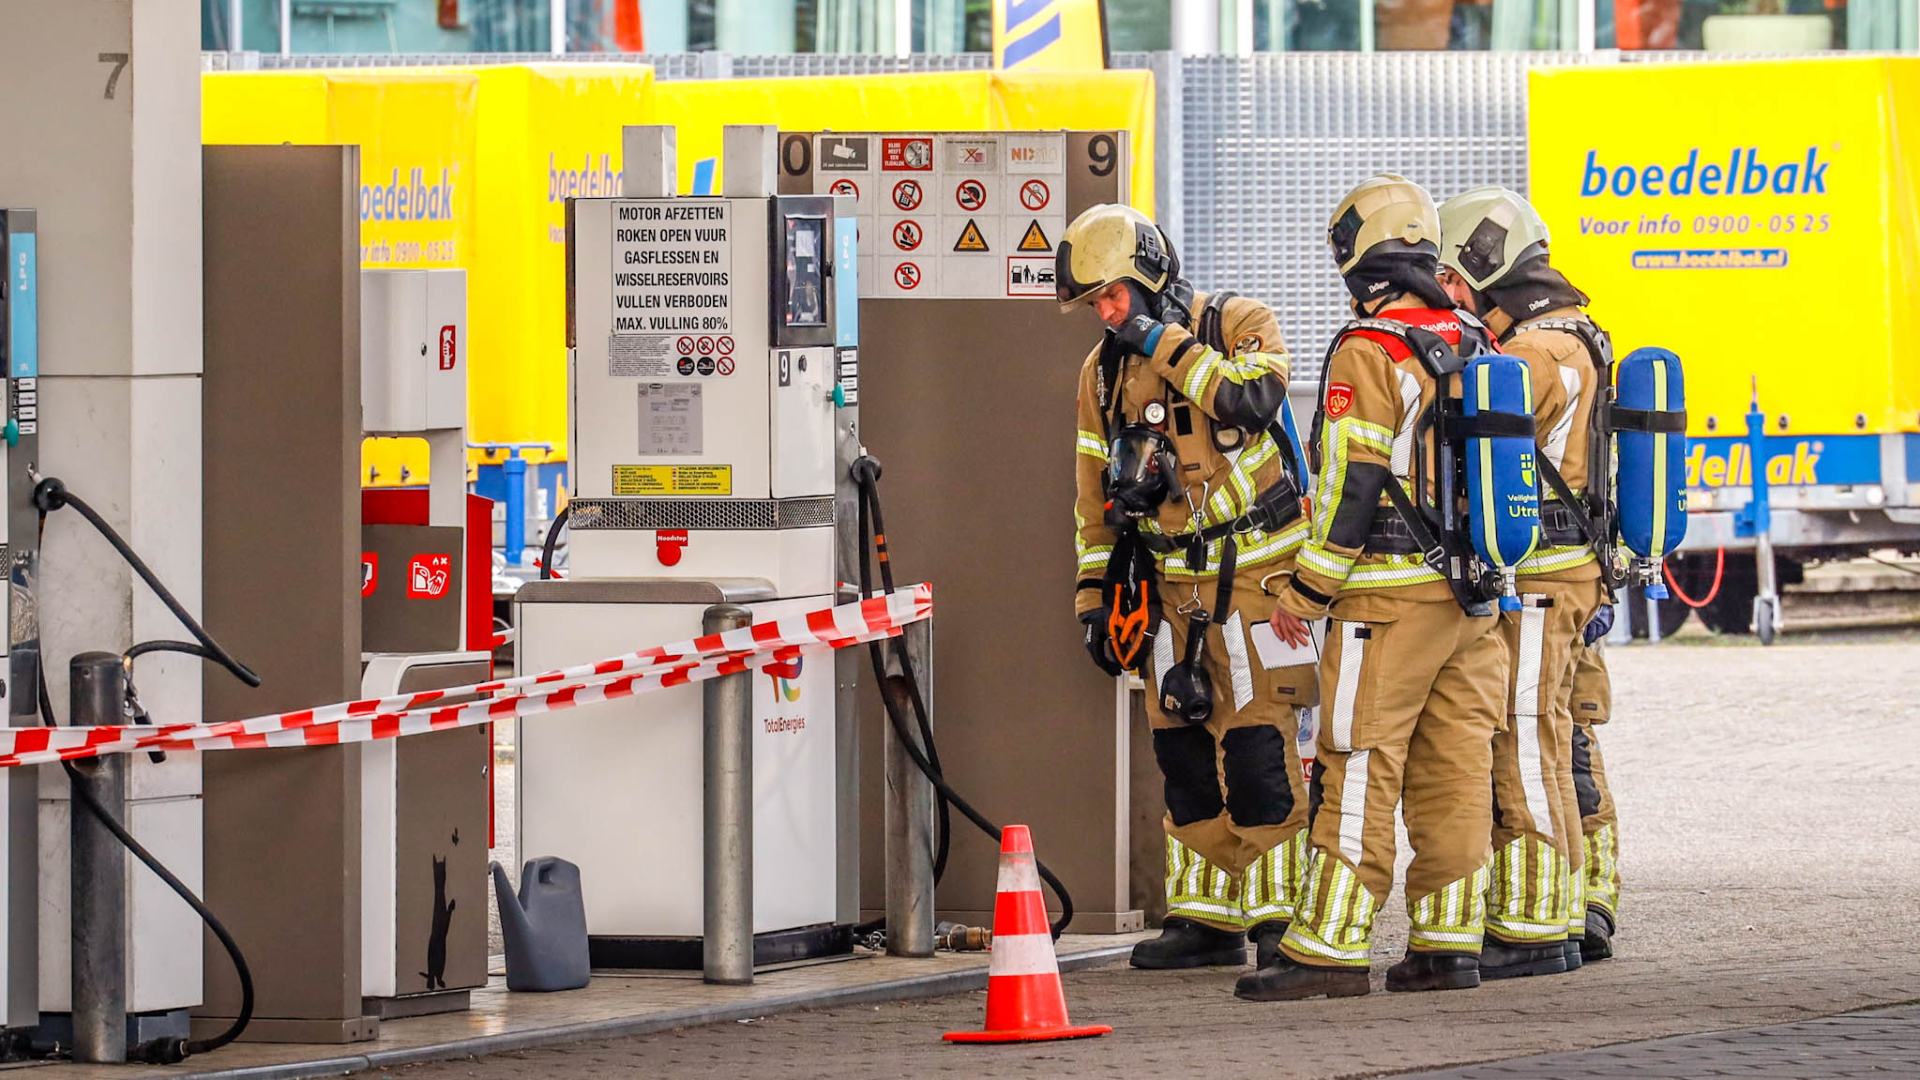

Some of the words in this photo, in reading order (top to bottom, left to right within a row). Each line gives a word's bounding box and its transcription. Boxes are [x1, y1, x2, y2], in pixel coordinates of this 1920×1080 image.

[98, 53, 128, 100] 7
[1088, 134, 1116, 177] 9
[1580, 146, 1830, 197] boedelbak
[620, 207, 660, 220] MOTOR
[664, 206, 723, 220] AFZETTEN
[1579, 216, 1630, 234] Voor
[1638, 214, 1681, 234] info
[1693, 214, 1750, 233] 0900
[617, 229, 656, 242] ROKEN
[660, 229, 691, 242] OPEN
[695, 229, 726, 241] VUUR
[624, 251, 699, 264] GASFLESSEN
[704, 251, 719, 264] EN
[615, 272, 728, 286] WISSELRESERVOIRS
[616, 295, 660, 308] VULLEN
[664, 295, 727, 308] VERBODEN
[616, 317, 646, 330] MAX.
[650, 317, 699, 330] VULLING
[703, 317, 728, 330] 80%
[780, 355, 788, 382] 9
[764, 717, 806, 734] TotalEnergies
